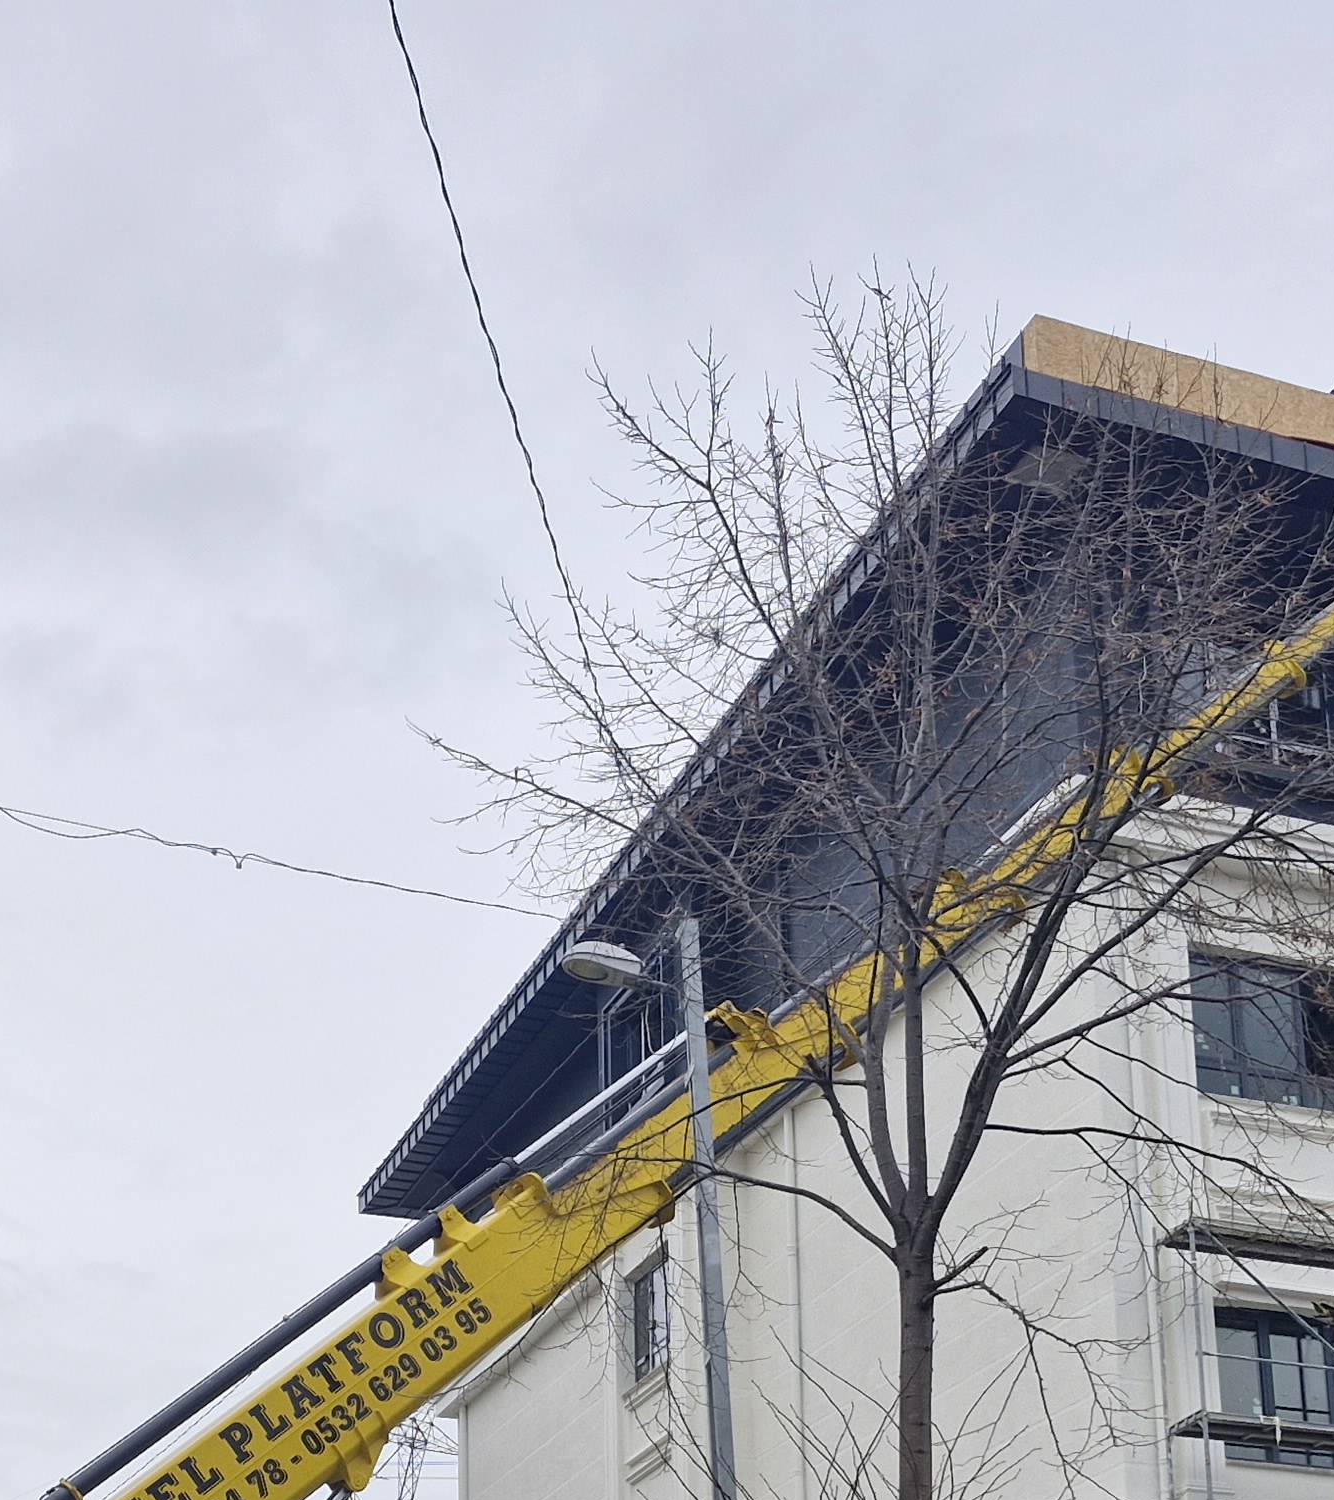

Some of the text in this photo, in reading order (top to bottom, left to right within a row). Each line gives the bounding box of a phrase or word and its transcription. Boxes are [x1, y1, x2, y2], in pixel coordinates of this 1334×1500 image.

[219, 1259, 473, 1465] PLATFORM
[247, 1457, 288, 1499] 78
[301, 1392, 373, 1456] 0532
[367, 1352, 422, 1402] 629
[424, 1325, 458, 1363] 03
[462, 1297, 492, 1335] 95
